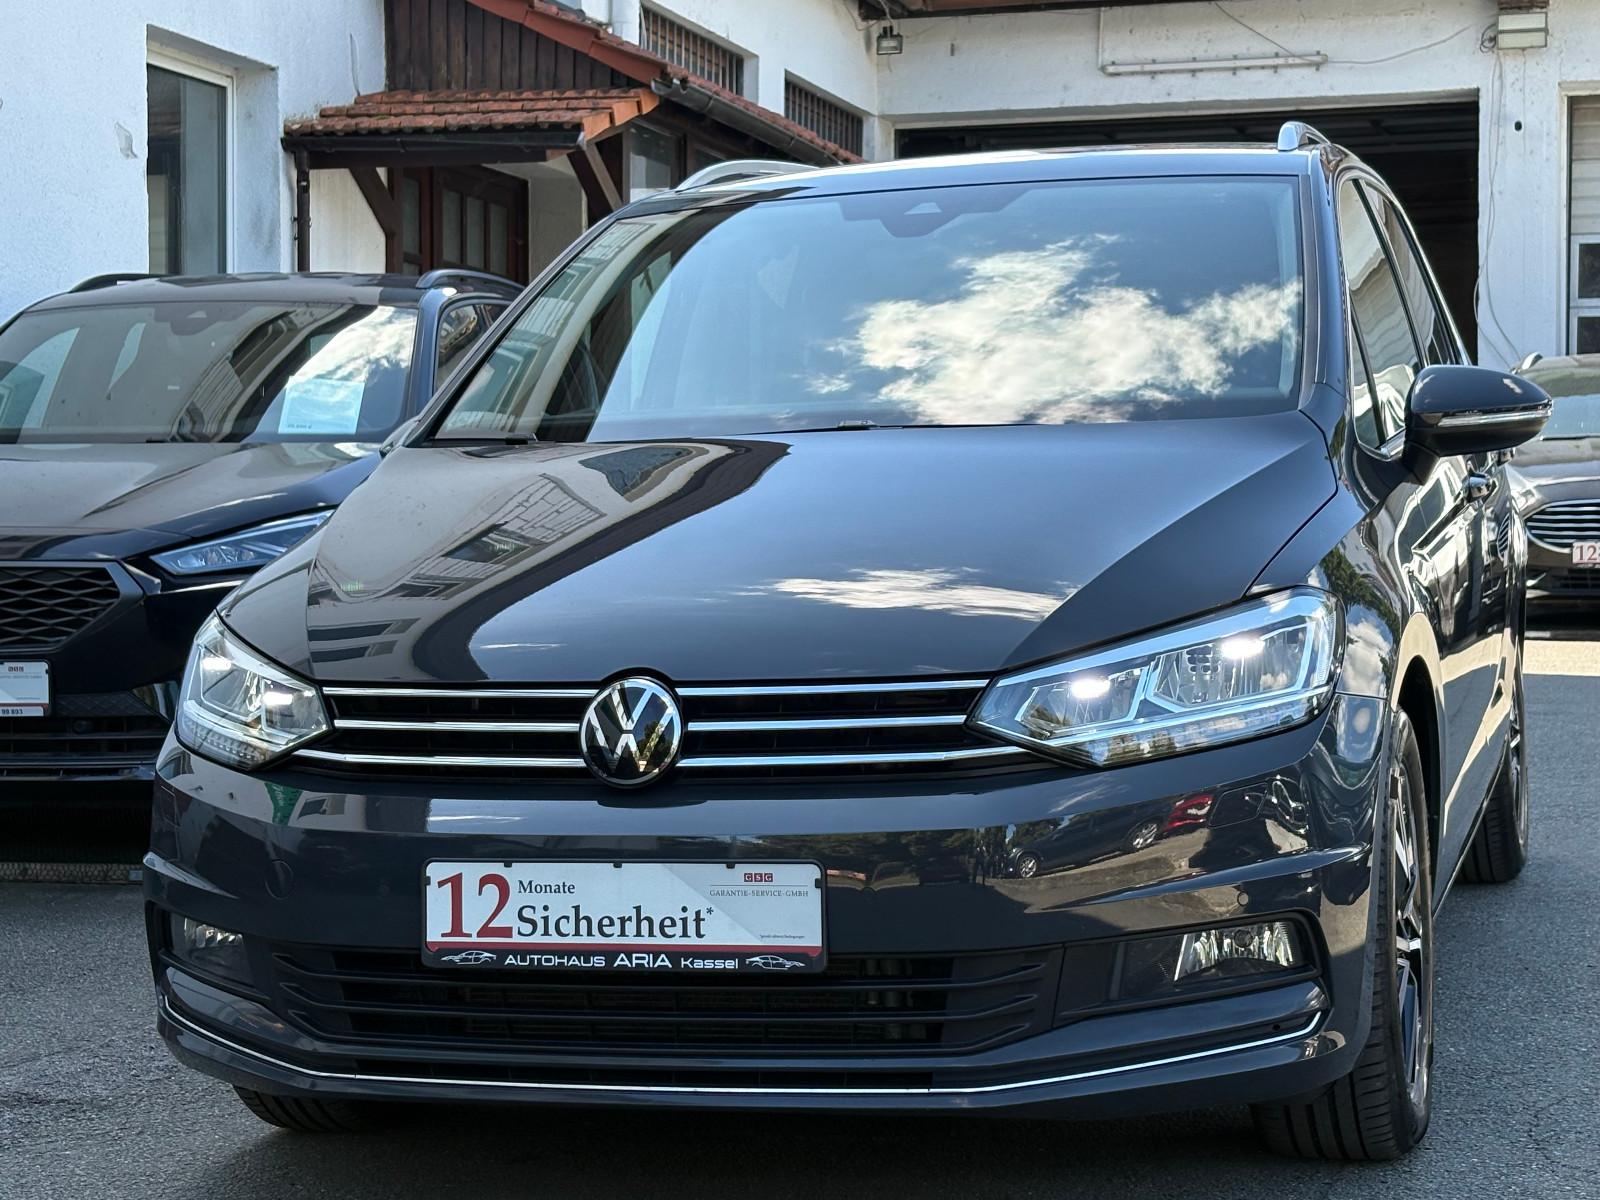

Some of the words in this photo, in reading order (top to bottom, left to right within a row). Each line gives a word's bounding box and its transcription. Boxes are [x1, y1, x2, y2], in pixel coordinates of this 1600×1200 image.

[1575, 544, 1598, 561] 12
[743, 872, 774, 883] GSG
[517, 879, 576, 894] Monate
[709, 889, 809, 898] GARANTIE-SERVICE-GMBH
[437, 871, 514, 939] 12
[503, 953, 607, 967] AUTOHAUS
[612, 953, 673, 969] ARIA
[680, 957, 739, 970] Kassel
